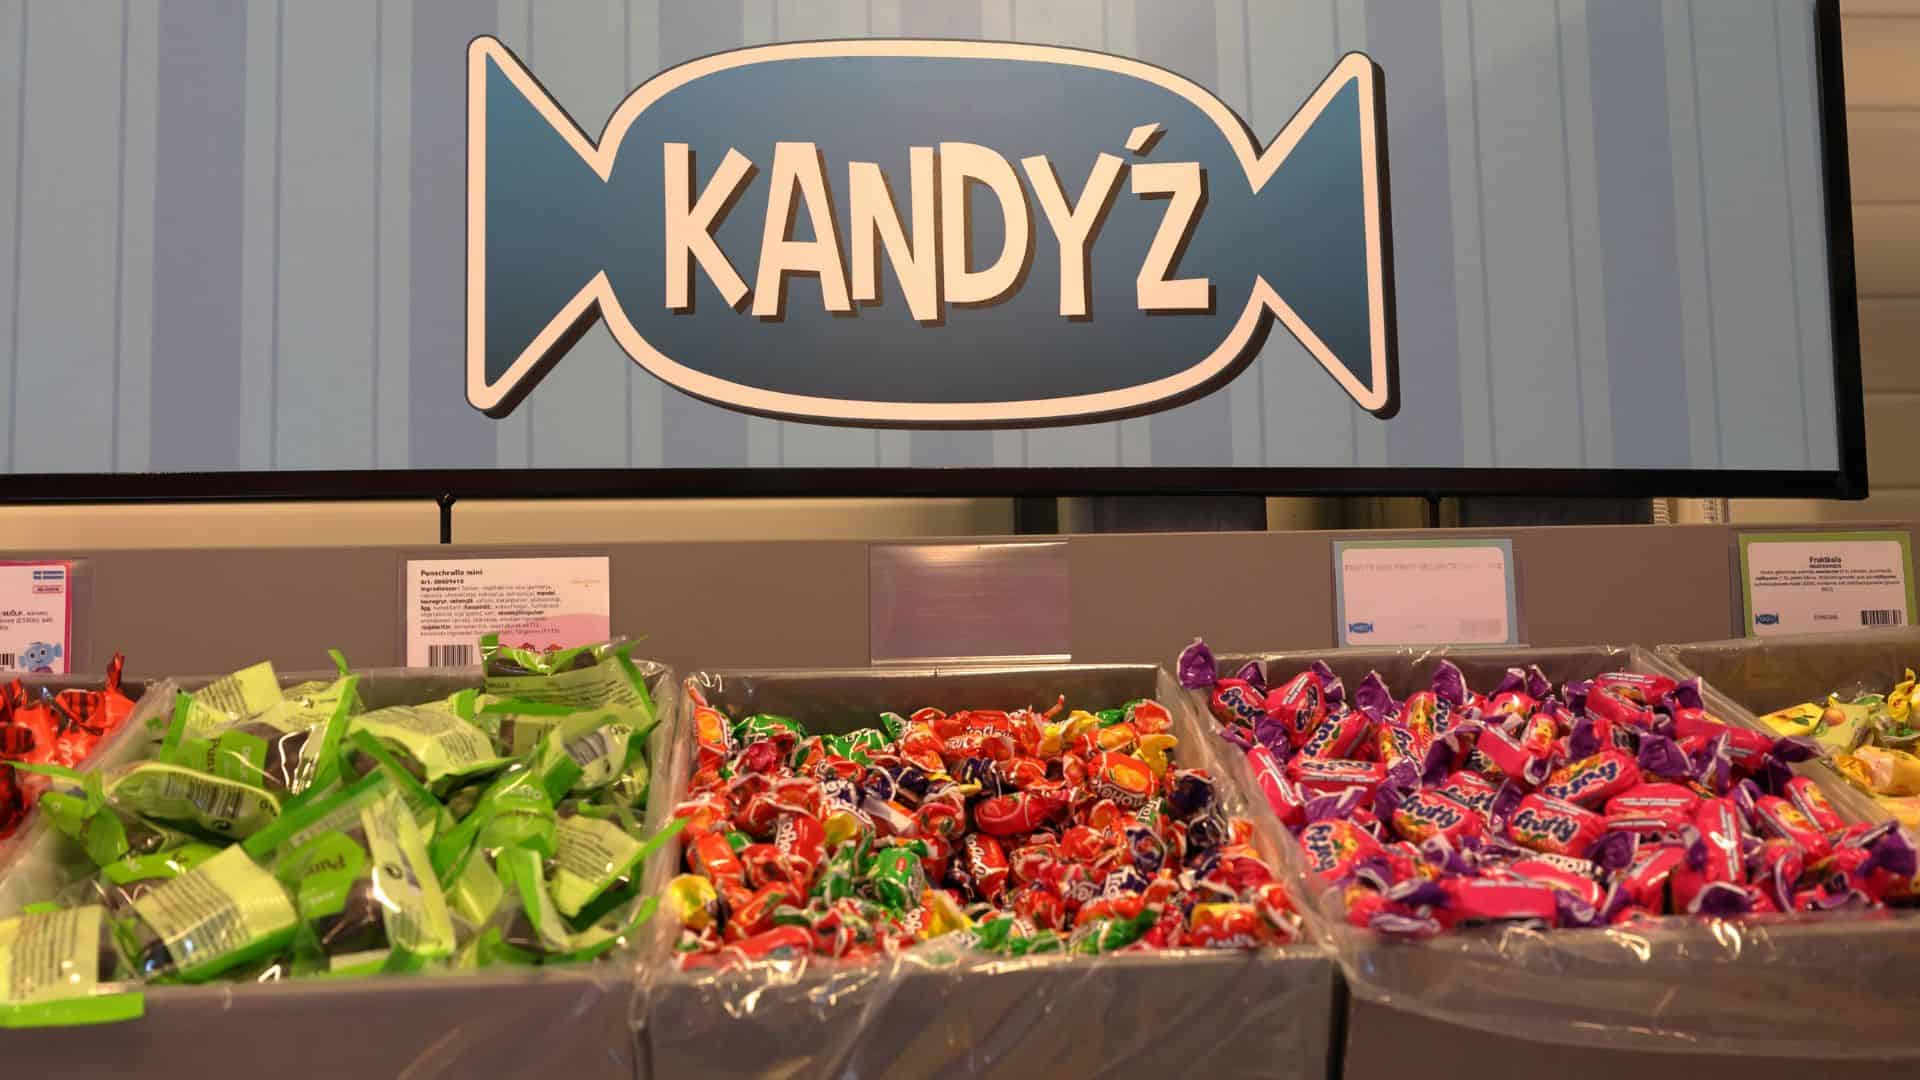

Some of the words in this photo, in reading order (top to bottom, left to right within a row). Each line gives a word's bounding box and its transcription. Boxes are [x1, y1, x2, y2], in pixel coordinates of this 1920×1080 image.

[662, 121, 1211, 321] KANDYŹ
[1401, 794, 1462, 829] frutty
[1513, 809, 1579, 843] frutty
